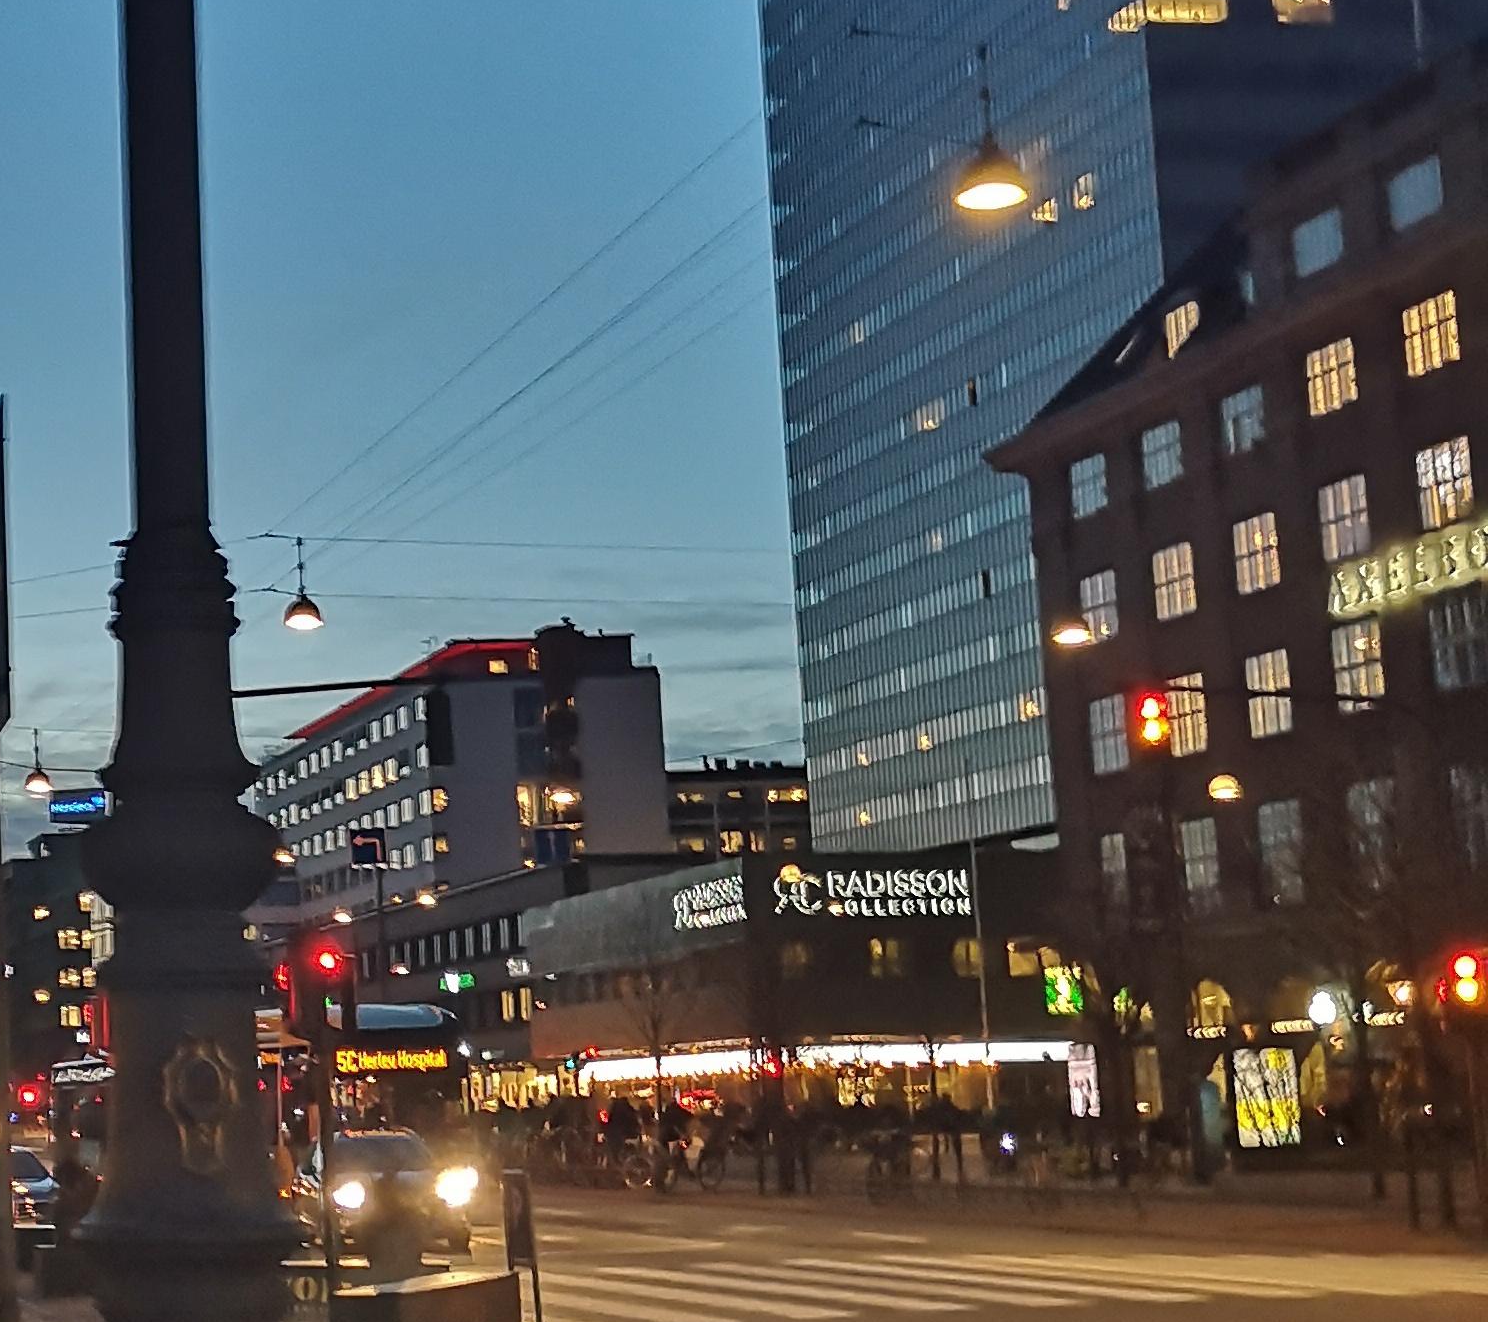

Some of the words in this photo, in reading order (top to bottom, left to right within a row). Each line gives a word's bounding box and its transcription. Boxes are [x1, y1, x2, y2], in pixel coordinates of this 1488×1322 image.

[826, 869, 970, 898] RADISSON
[829, 897, 971, 917] OLLECTION
[397, 1048, 448, 1072] Hospital
